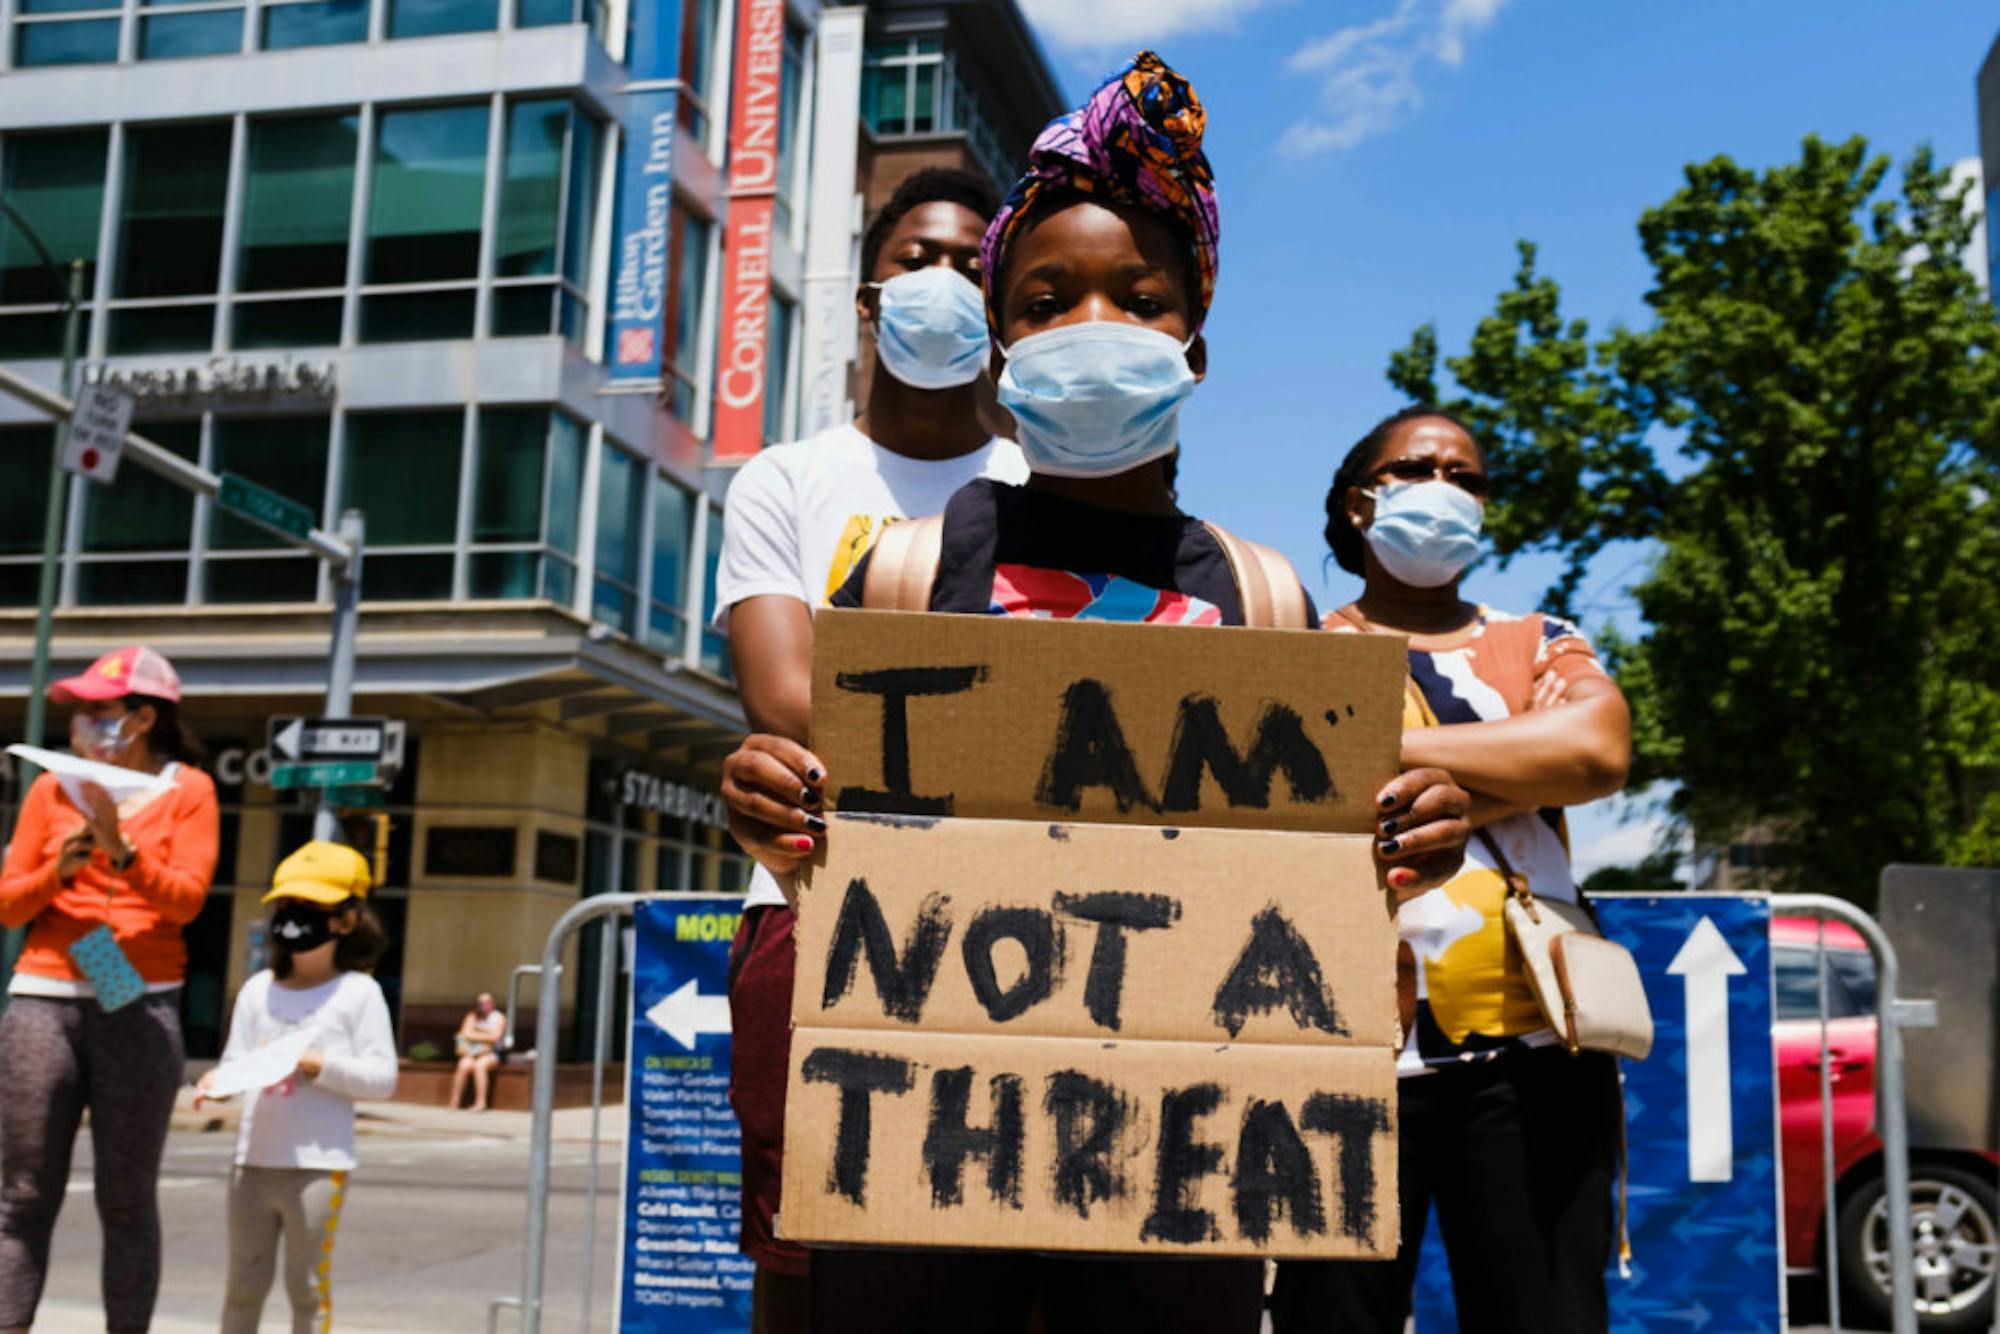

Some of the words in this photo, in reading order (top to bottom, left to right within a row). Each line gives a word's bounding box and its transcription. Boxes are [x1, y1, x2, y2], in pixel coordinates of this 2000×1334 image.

[643, 112, 673, 174] Inn
[613, 228, 643, 321] Hilton
[637, 184, 669, 320] Garden
[721, 211, 770, 408] CORNELL
[834, 664, 990, 820] I
[1035, 677, 1340, 814] AM
[821, 876, 1183, 1031] NOT
[1210, 899, 1351, 1039] A
[802, 1046, 1393, 1250] THREAT
